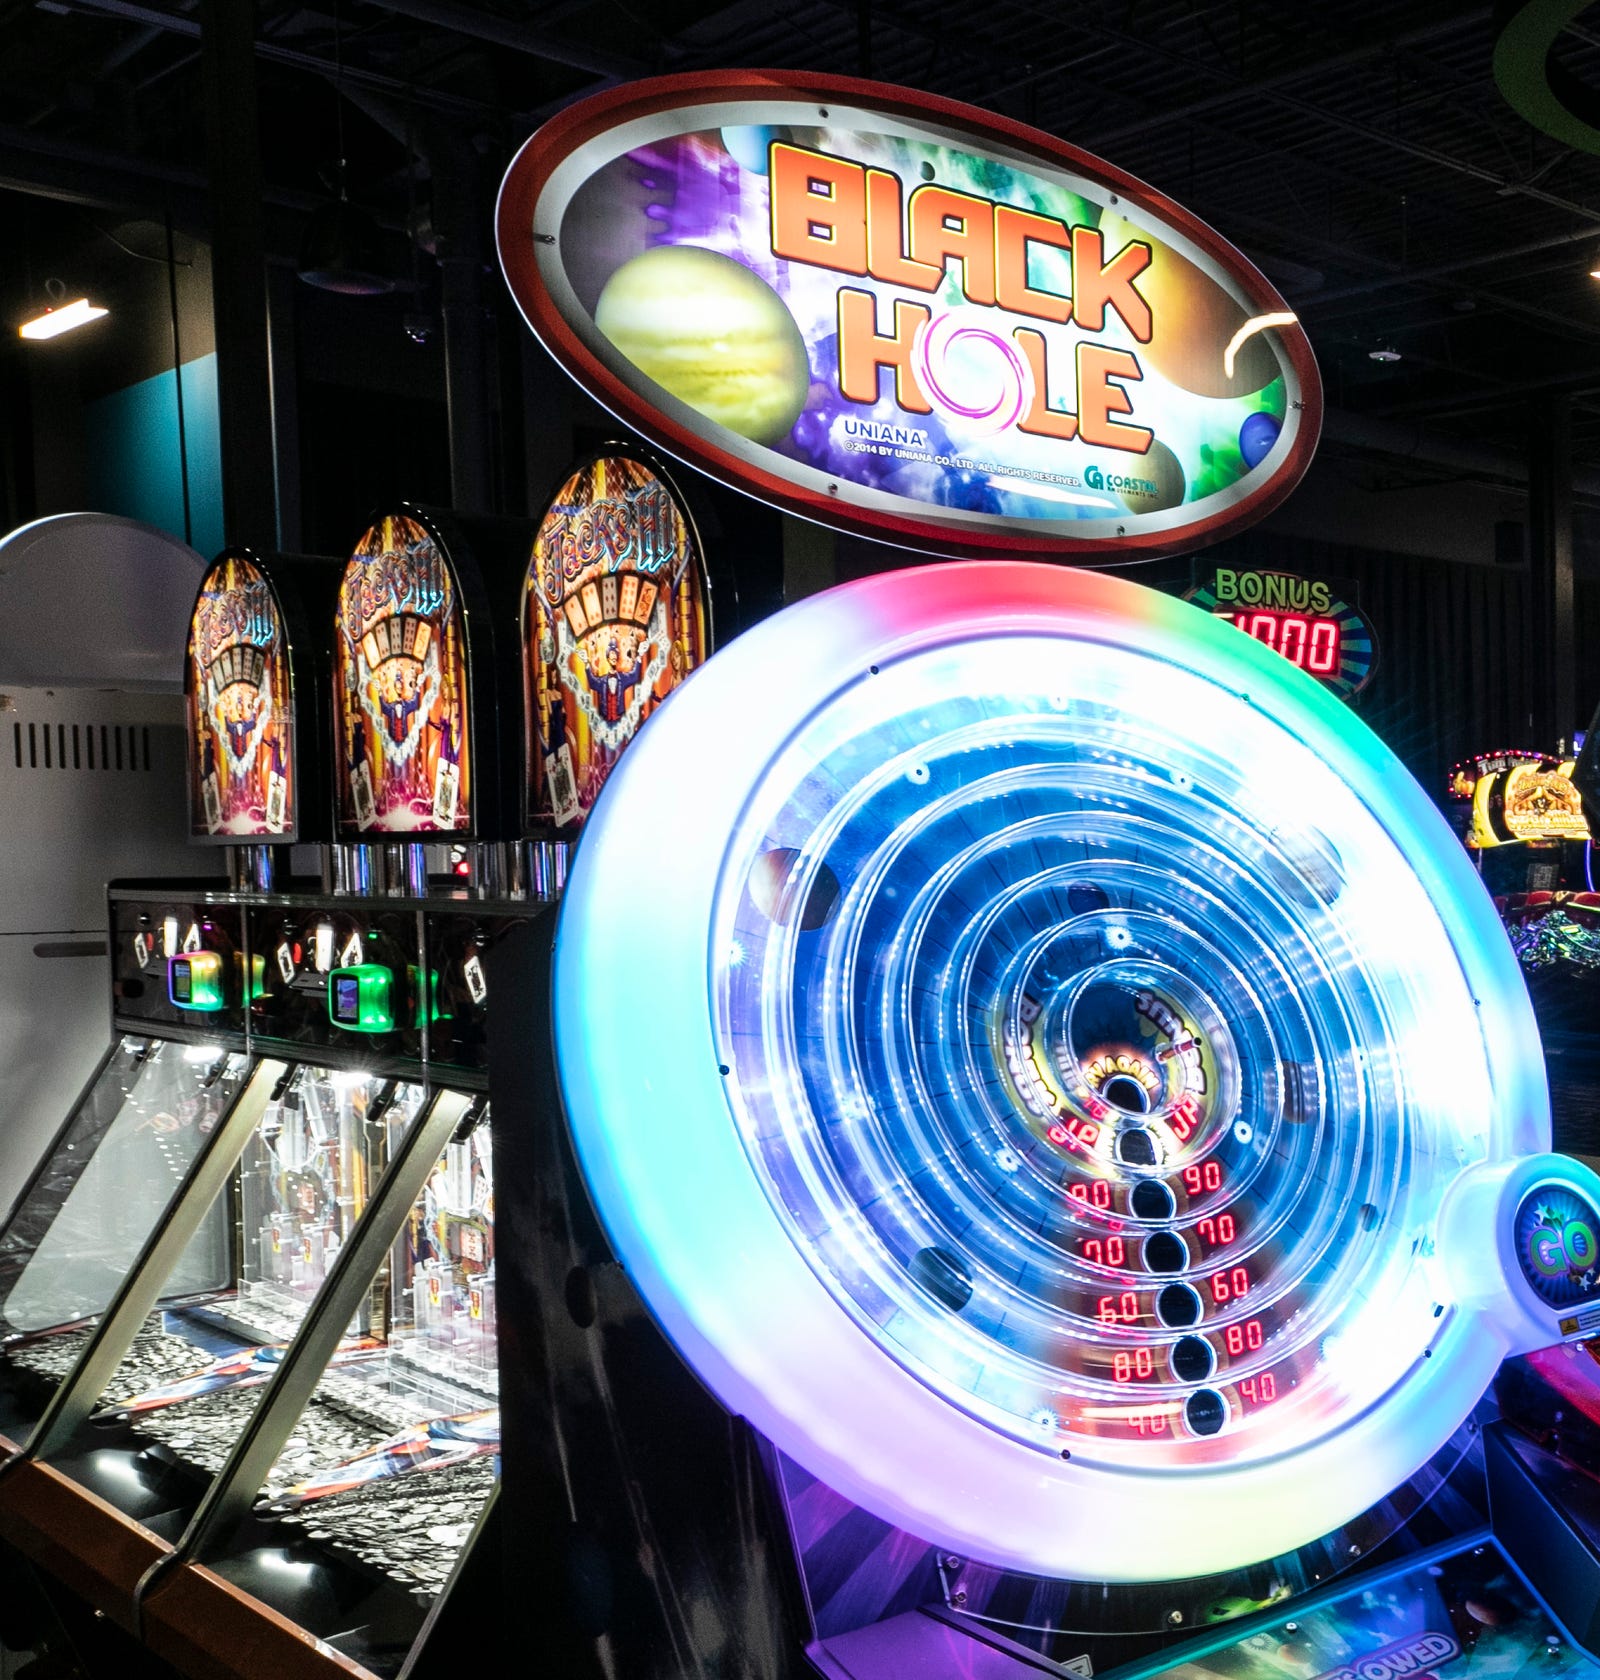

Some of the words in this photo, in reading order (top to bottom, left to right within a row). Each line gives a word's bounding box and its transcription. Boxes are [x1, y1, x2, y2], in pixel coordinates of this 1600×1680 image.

[769, 139, 1152, 343] BLACK
[837, 286, 1154, 455] HOLE
[844, 420, 923, 446] UNIANA
[878, 446, 893, 457] BY
[895, 449, 933, 463] UNIANA
[978, 462, 995, 473] ALL
[998, 465, 1032, 479] RIGHTS
[1033, 471, 1082, 487] RESERVED.
[1106, 474, 1159, 494] COASTAL
[1215, 568, 1333, 613] BONUS
[1104, 1054, 1160, 1091] AGAIN
[1185, 1161, 1221, 1194] 90
[1199, 1214, 1235, 1245] 70
[1085, 1236, 1124, 1266] 70
[1529, 1221, 1597, 1277] GO
[1212, 1268, 1248, 1301] 60
[1099, 1292, 1138, 1323] 60
[1227, 1321, 1262, 1355] 80
[1113, 1347, 1152, 1382] 80
[1241, 1373, 1276, 1403] 40
[1363, 1637, 1452, 1680] OWED
